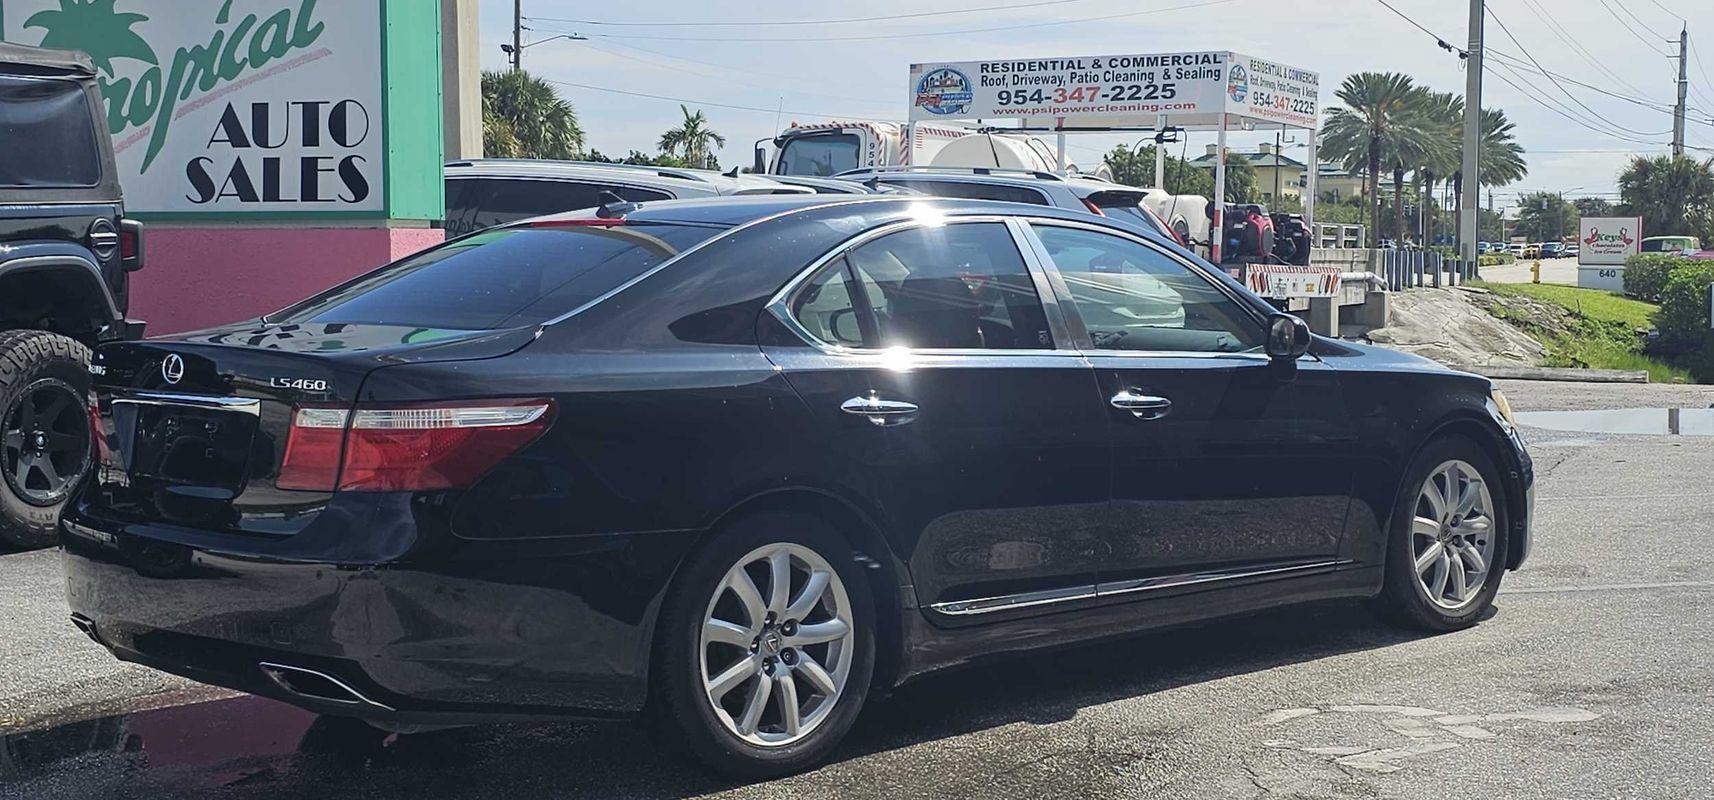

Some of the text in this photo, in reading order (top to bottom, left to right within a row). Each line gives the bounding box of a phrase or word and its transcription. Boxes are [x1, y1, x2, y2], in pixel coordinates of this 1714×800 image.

[980, 54, 1222, 74] RESIDENTIAL & COMMERCIAL
[1250, 59, 1282, 78] RESIDENTIAL
[1288, 68, 1319, 86] COMMERCIAL
[97, 0, 325, 175] ropical
[980, 66, 1221, 88] Roof, Driveway, Patio Cleaning & Sealing
[997, 83, 1177, 106] 954-347-2225
[1253, 91, 1315, 115] 954-347-2225
[992, 102, 1196, 116] www.psipowercleaning.com
[207, 99, 369, 149] AUTO
[186, 154, 369, 204] SALES
[1597, 233, 1623, 242] Keys
[1599, 269, 1616, 278] 640
[270, 377, 327, 391] LS460
